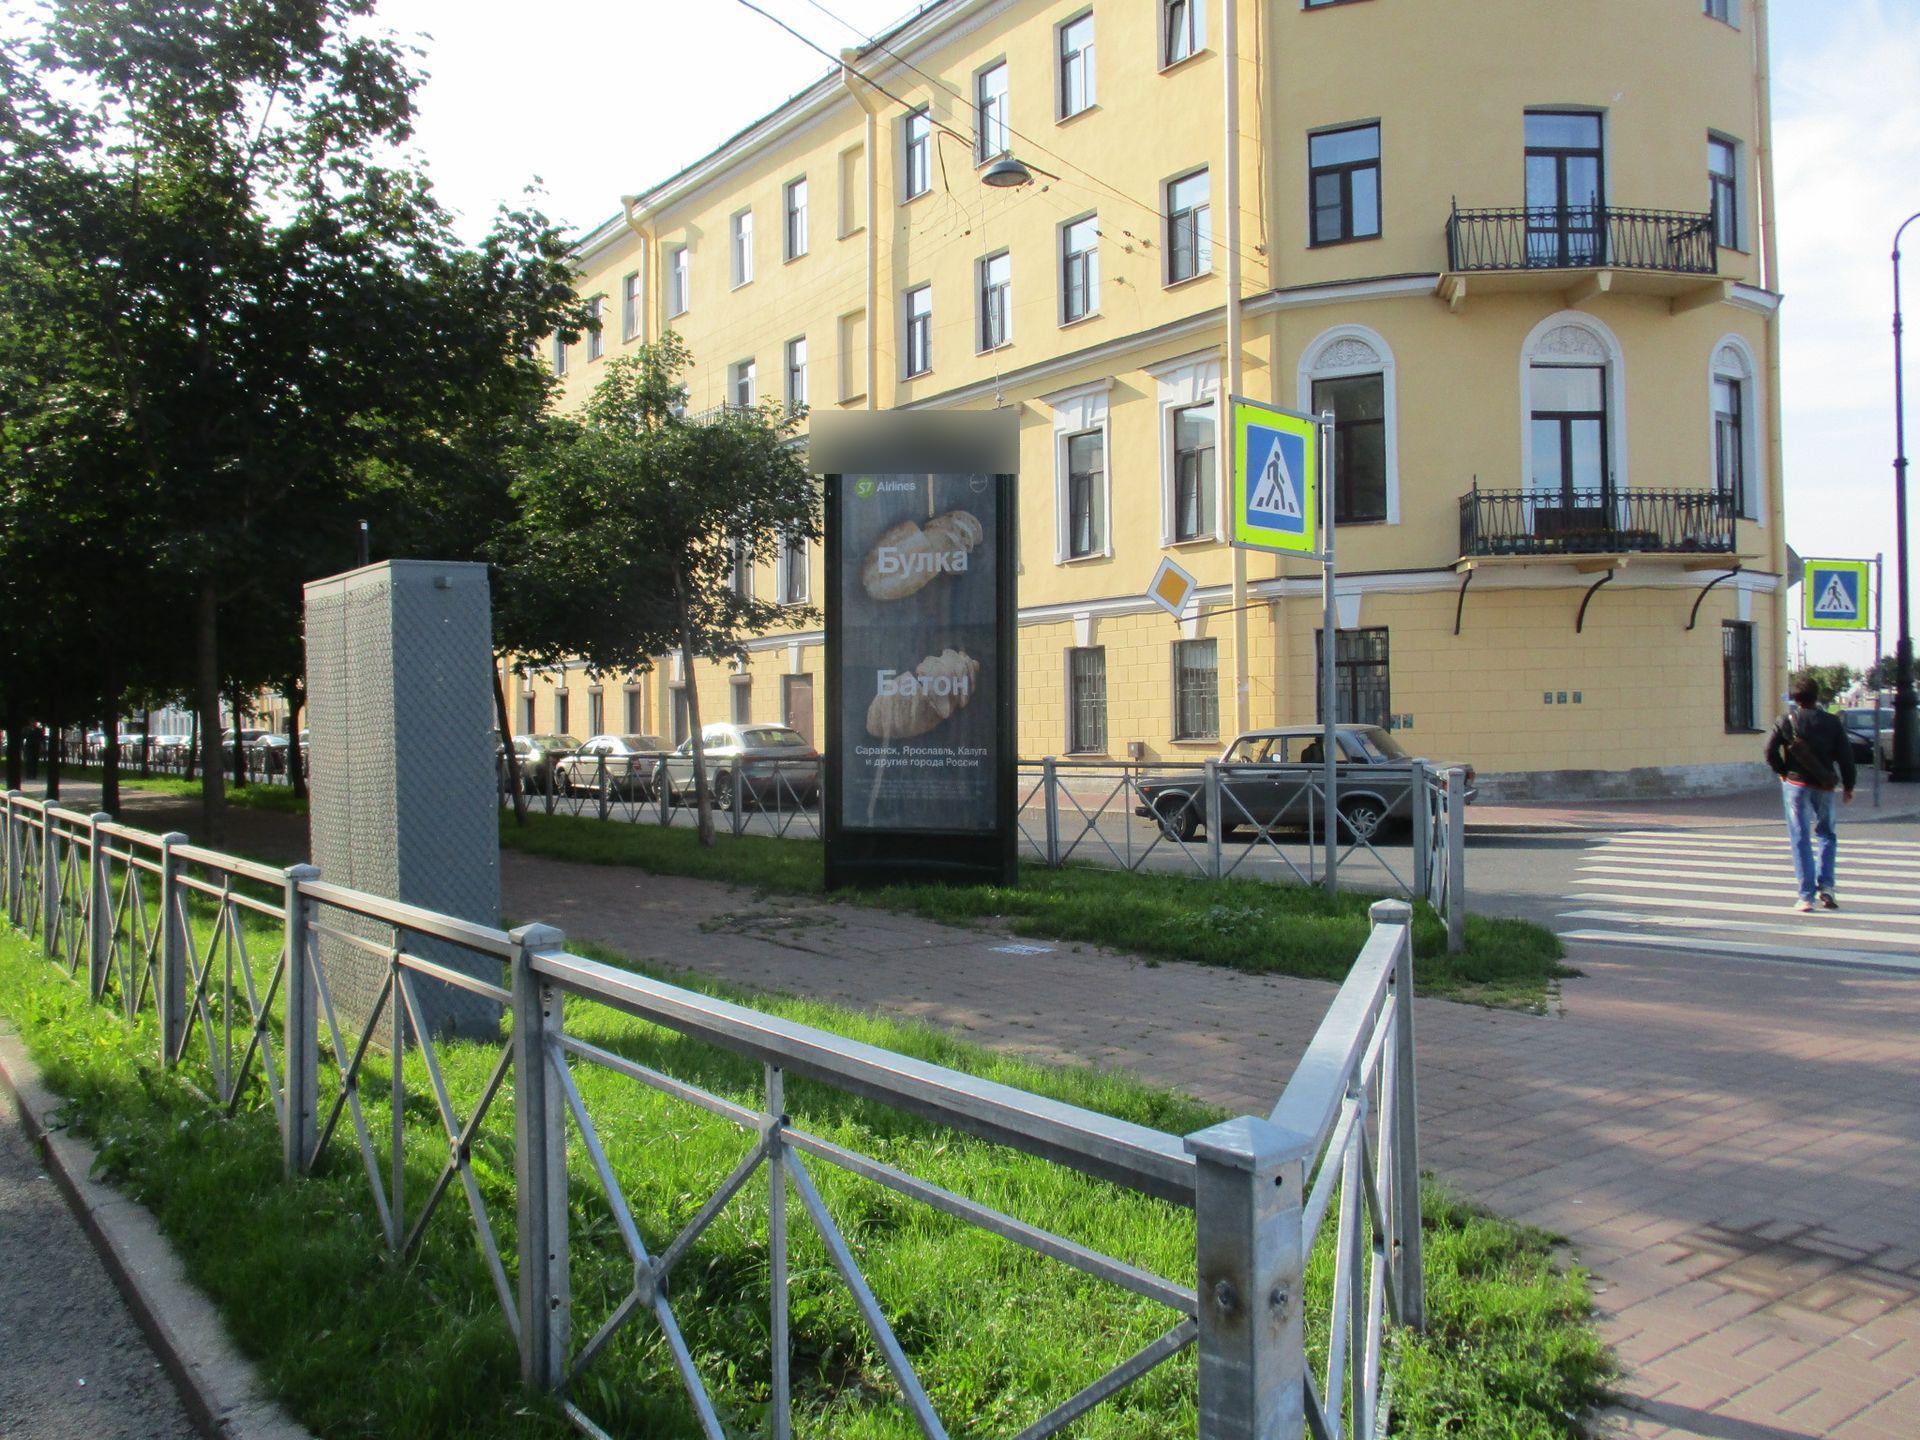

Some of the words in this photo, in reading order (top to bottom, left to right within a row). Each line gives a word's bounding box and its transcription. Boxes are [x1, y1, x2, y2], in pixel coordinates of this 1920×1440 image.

[858, 481, 873, 495] S7
[877, 481, 917, 492] Airlines
[878, 546, 967, 578] Булка
[877, 669, 968, 696] Батон
[856, 745, 900, 756] Саранск,
[903, 745, 956, 756] Ярославль,
[958, 746, 988, 756] Калуга
[874, 758, 908, 767] другие
[911, 758, 944, 767] города
[946, 758, 979, 767] России
